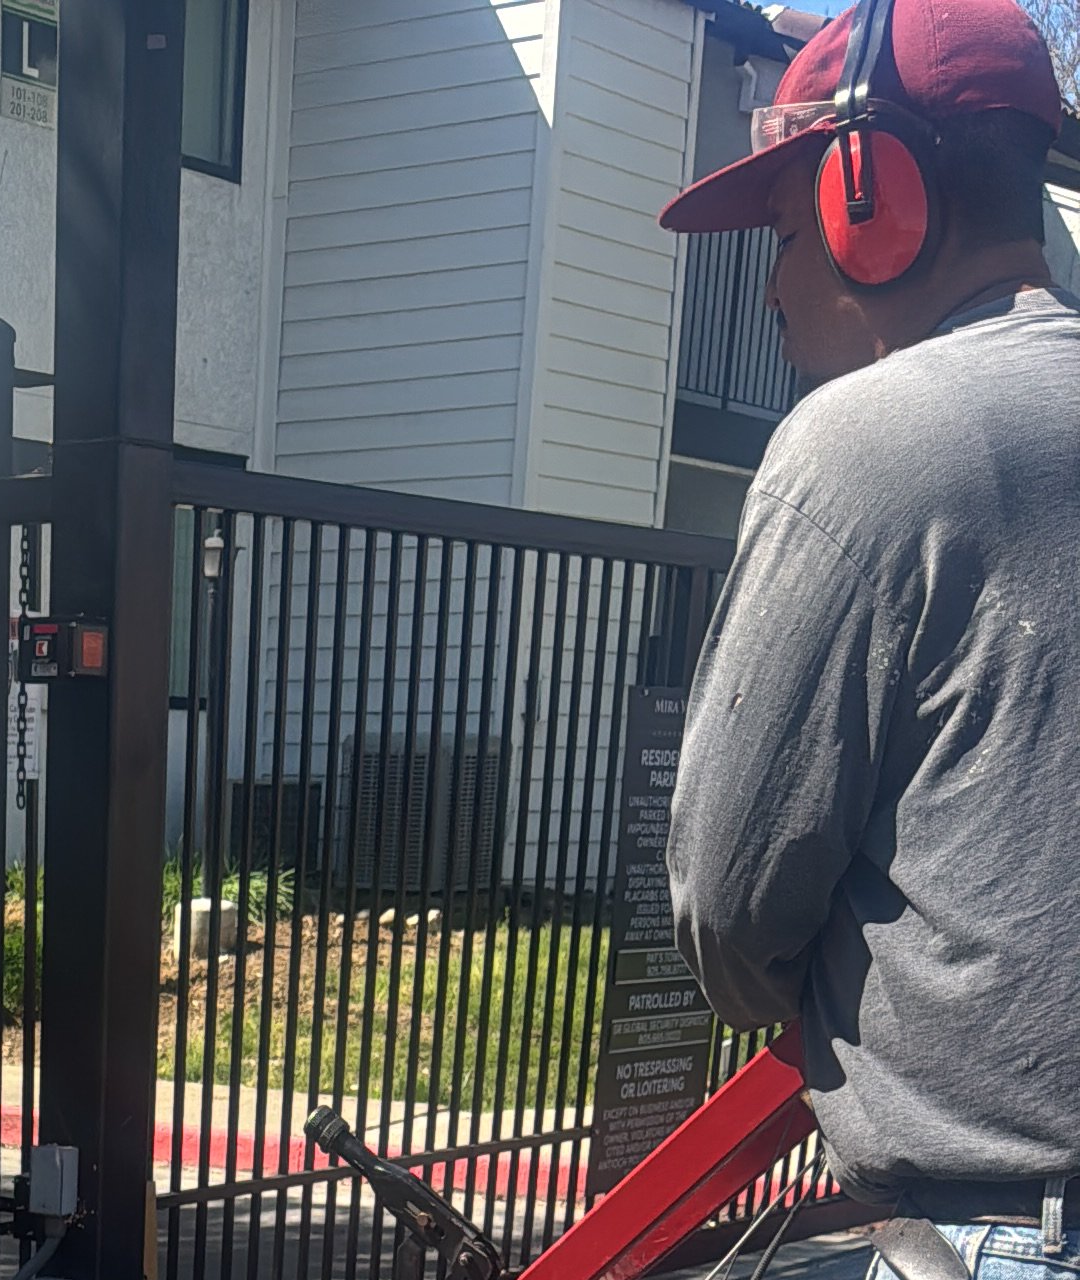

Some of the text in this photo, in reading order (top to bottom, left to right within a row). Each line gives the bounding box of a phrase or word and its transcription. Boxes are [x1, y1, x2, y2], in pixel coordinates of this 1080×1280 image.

[22, 20, 39, 78] L
[10, 101, 48, 123] 201-208
[654, 699, 679, 714] MIRA
[650, 770, 676, 788] PARK
[629, 795, 671, 808] UNAUTHOR
[629, 990, 697, 1011] PATROLLED BY
[616, 1056, 694, 1080] NO TRESPASSING
[620, 1076, 686, 1099] OR LOITERING
